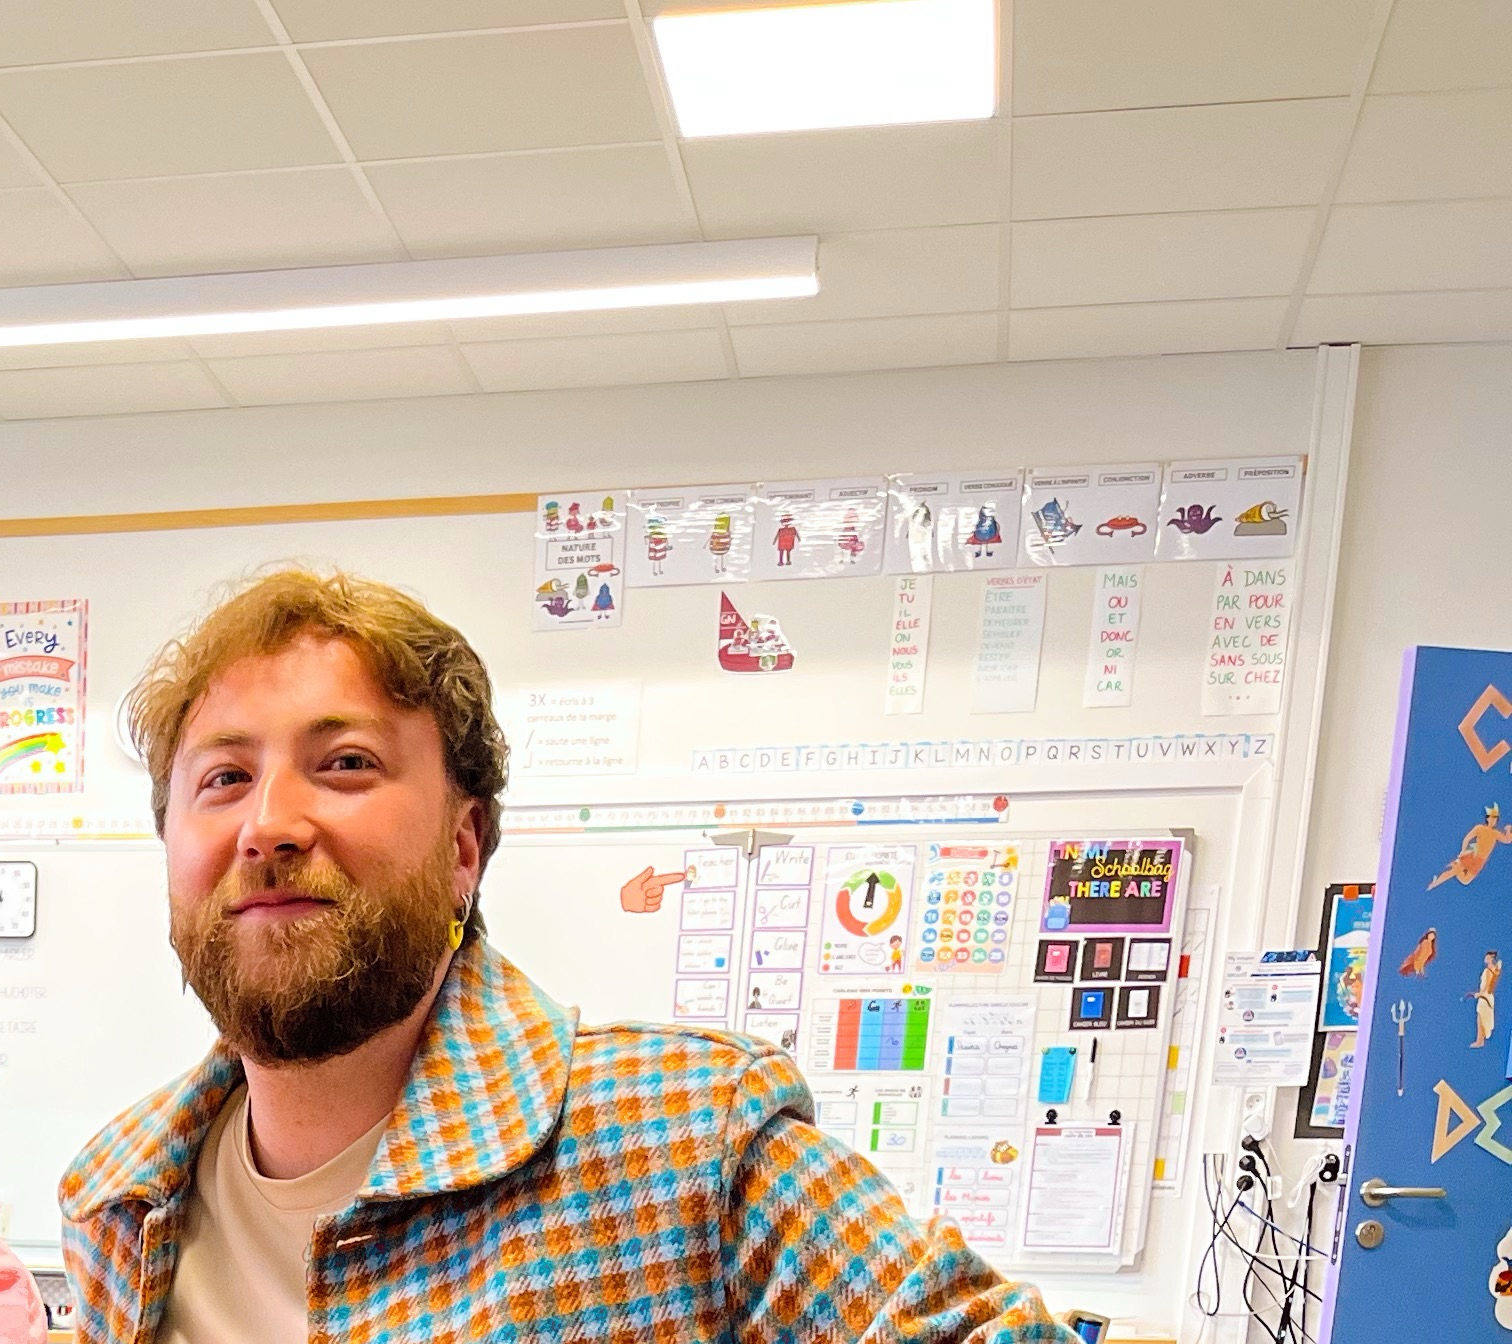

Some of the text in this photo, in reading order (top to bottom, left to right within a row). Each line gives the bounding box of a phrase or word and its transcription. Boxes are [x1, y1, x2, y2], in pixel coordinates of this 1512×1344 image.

[1103, 474, 1150, 482] CONJONCTION
[1183, 471, 1216, 479] ADVERBE
[1244, 468, 1289, 477] PRÉPOSITION
[561, 543, 596, 553] NATURE
[576, 554, 600, 563] MOTS
[1103, 573, 1138, 589] MAIS
[1222, 564, 1287, 587] À DANS
[901, 578, 917, 590] JE
[899, 593, 915, 604] TU
[1108, 596, 1129, 609] OU
[1216, 593, 1285, 611] PAR POUR
[899, 608, 911, 617] IL
[1108, 612, 1127, 625] ET
[896, 618, 920, 630] ELLE
[1214, 615, 1281, 630] EN VERS
[895, 633, 910, 643] ON
[1100, 630, 1135, 643] DONC
[1211, 634, 1279, 649] AVEC DE
[892, 645, 918, 656] NOUS
[1106, 648, 1124, 658] OR
[892, 660, 913, 670] VOUS
[1210, 652, 1283, 667] SANS SOUS
[1104, 665, 1117, 675] NI
[1207, 670, 1281, 685] SUR CHEZ
[28, 683, 61, 696] make
[889, 686, 916, 696] ELLES
[1097, 680, 1124, 692] CAR
[566, 713, 576, 722] de
[589, 713, 617, 724] marge
[590, 735, 610, 747] ligne
[698, 740, 1267, 770] A B C D E F G H I J K L M N O P Q R S T U V W X Y Z
[602, 756, 623, 767] ligne
[775, 851, 809, 865] Write
[1059, 844, 1078, 860] IN
[1091, 856, 1174, 882] Schoolbag
[1069, 880, 1162, 898] THERE ARE
[780, 894, 801, 909] Cut
[775, 936, 799, 952] Glue
[775, 975, 788, 986] Be
